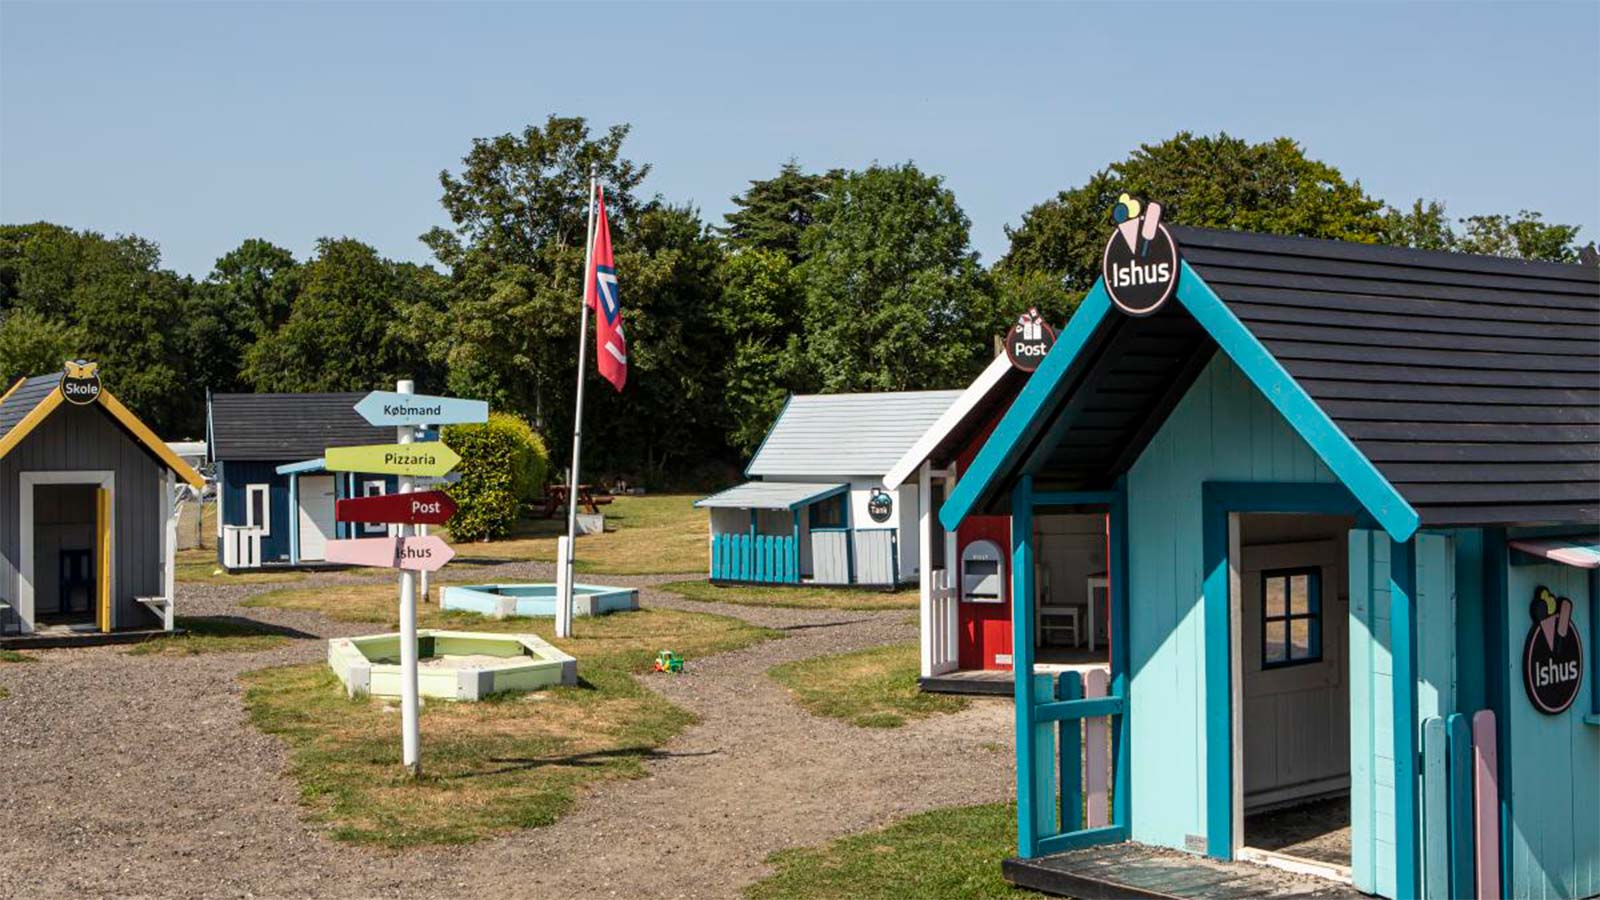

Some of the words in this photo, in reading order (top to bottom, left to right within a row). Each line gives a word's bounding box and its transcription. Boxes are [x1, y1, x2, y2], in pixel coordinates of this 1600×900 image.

[1113, 260, 1170, 287] Ishus
[1015, 342, 1046, 356] Post
[65, 383, 98, 394] Skole
[384, 404, 441, 416] Købmand
[384, 453, 436, 465] Pizzaria
[412, 501, 440, 513] Post
[396, 546, 432, 559] Ishus
[1536, 658, 1578, 687] Ishus
